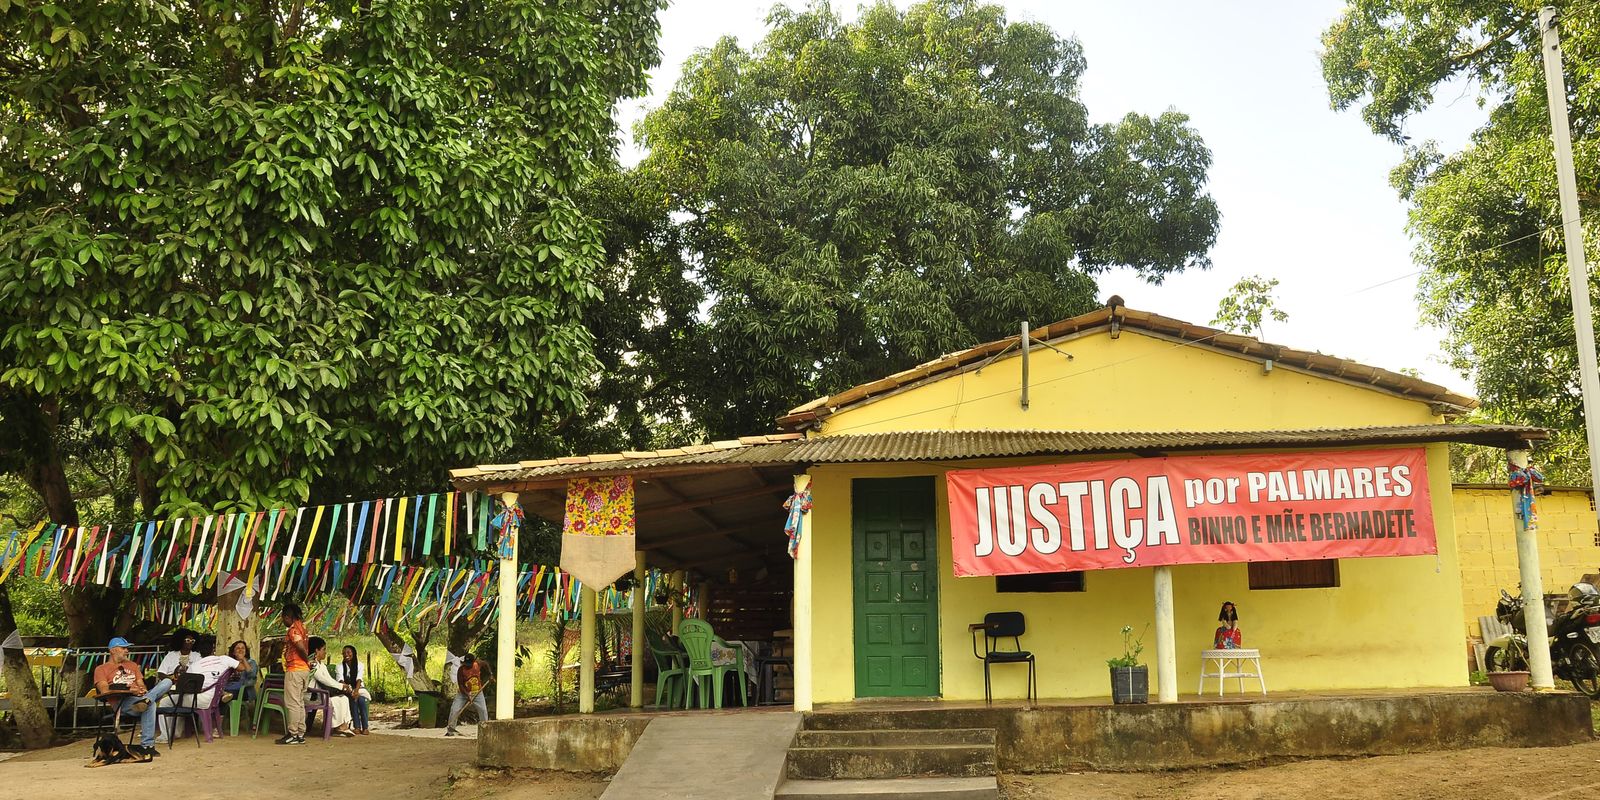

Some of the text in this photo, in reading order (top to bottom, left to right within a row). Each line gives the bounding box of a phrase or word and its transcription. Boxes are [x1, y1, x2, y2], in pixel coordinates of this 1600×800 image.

[974, 465, 1413, 564] JUSTIÇA por PALMARES
[1188, 508, 1417, 545] BINHO E MÃE BERNADETE
